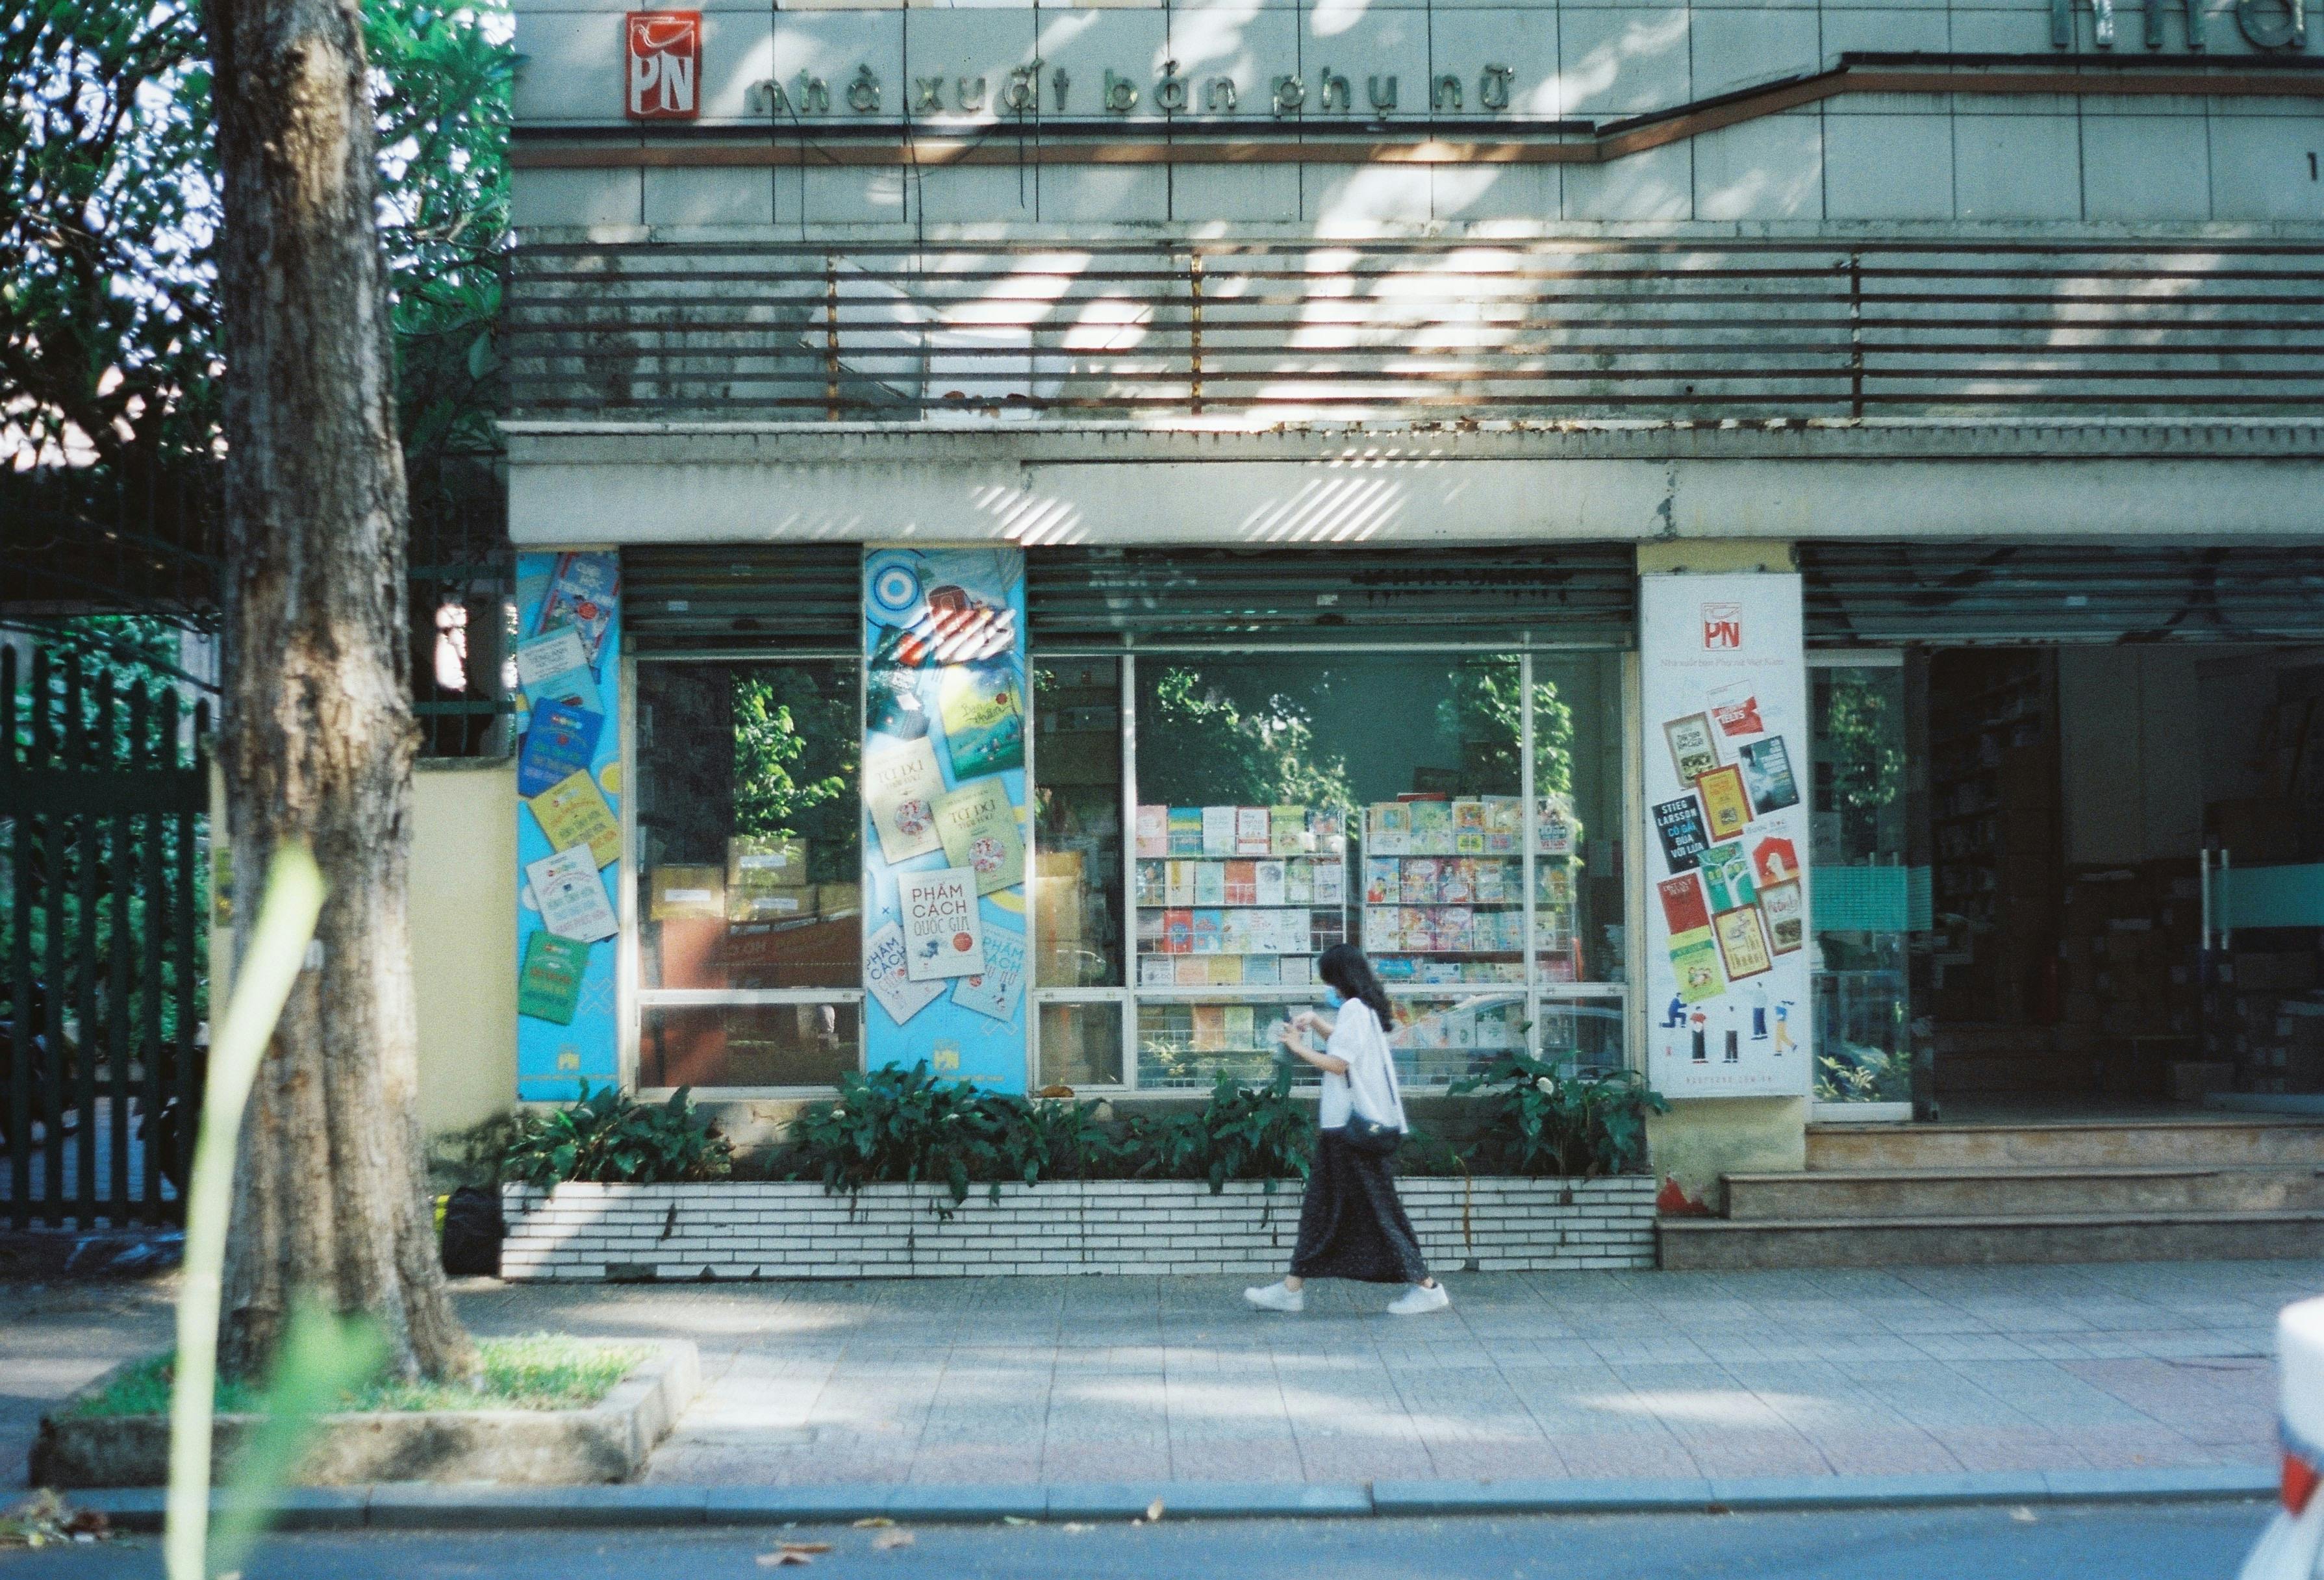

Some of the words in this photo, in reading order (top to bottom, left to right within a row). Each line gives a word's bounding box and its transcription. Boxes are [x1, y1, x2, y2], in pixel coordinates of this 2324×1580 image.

[631, 50, 693, 113] PN
[744, 64, 881, 112] nhà
[915, 57, 1069, 112] xuất
[1105, 60, 1237, 112] bản
[1272, 66, 1398, 120] phụ
[1434, 64, 1515, 110] nữ
[1704, 620, 1740, 649] PN
[913, 897, 967, 919] CÁCH
